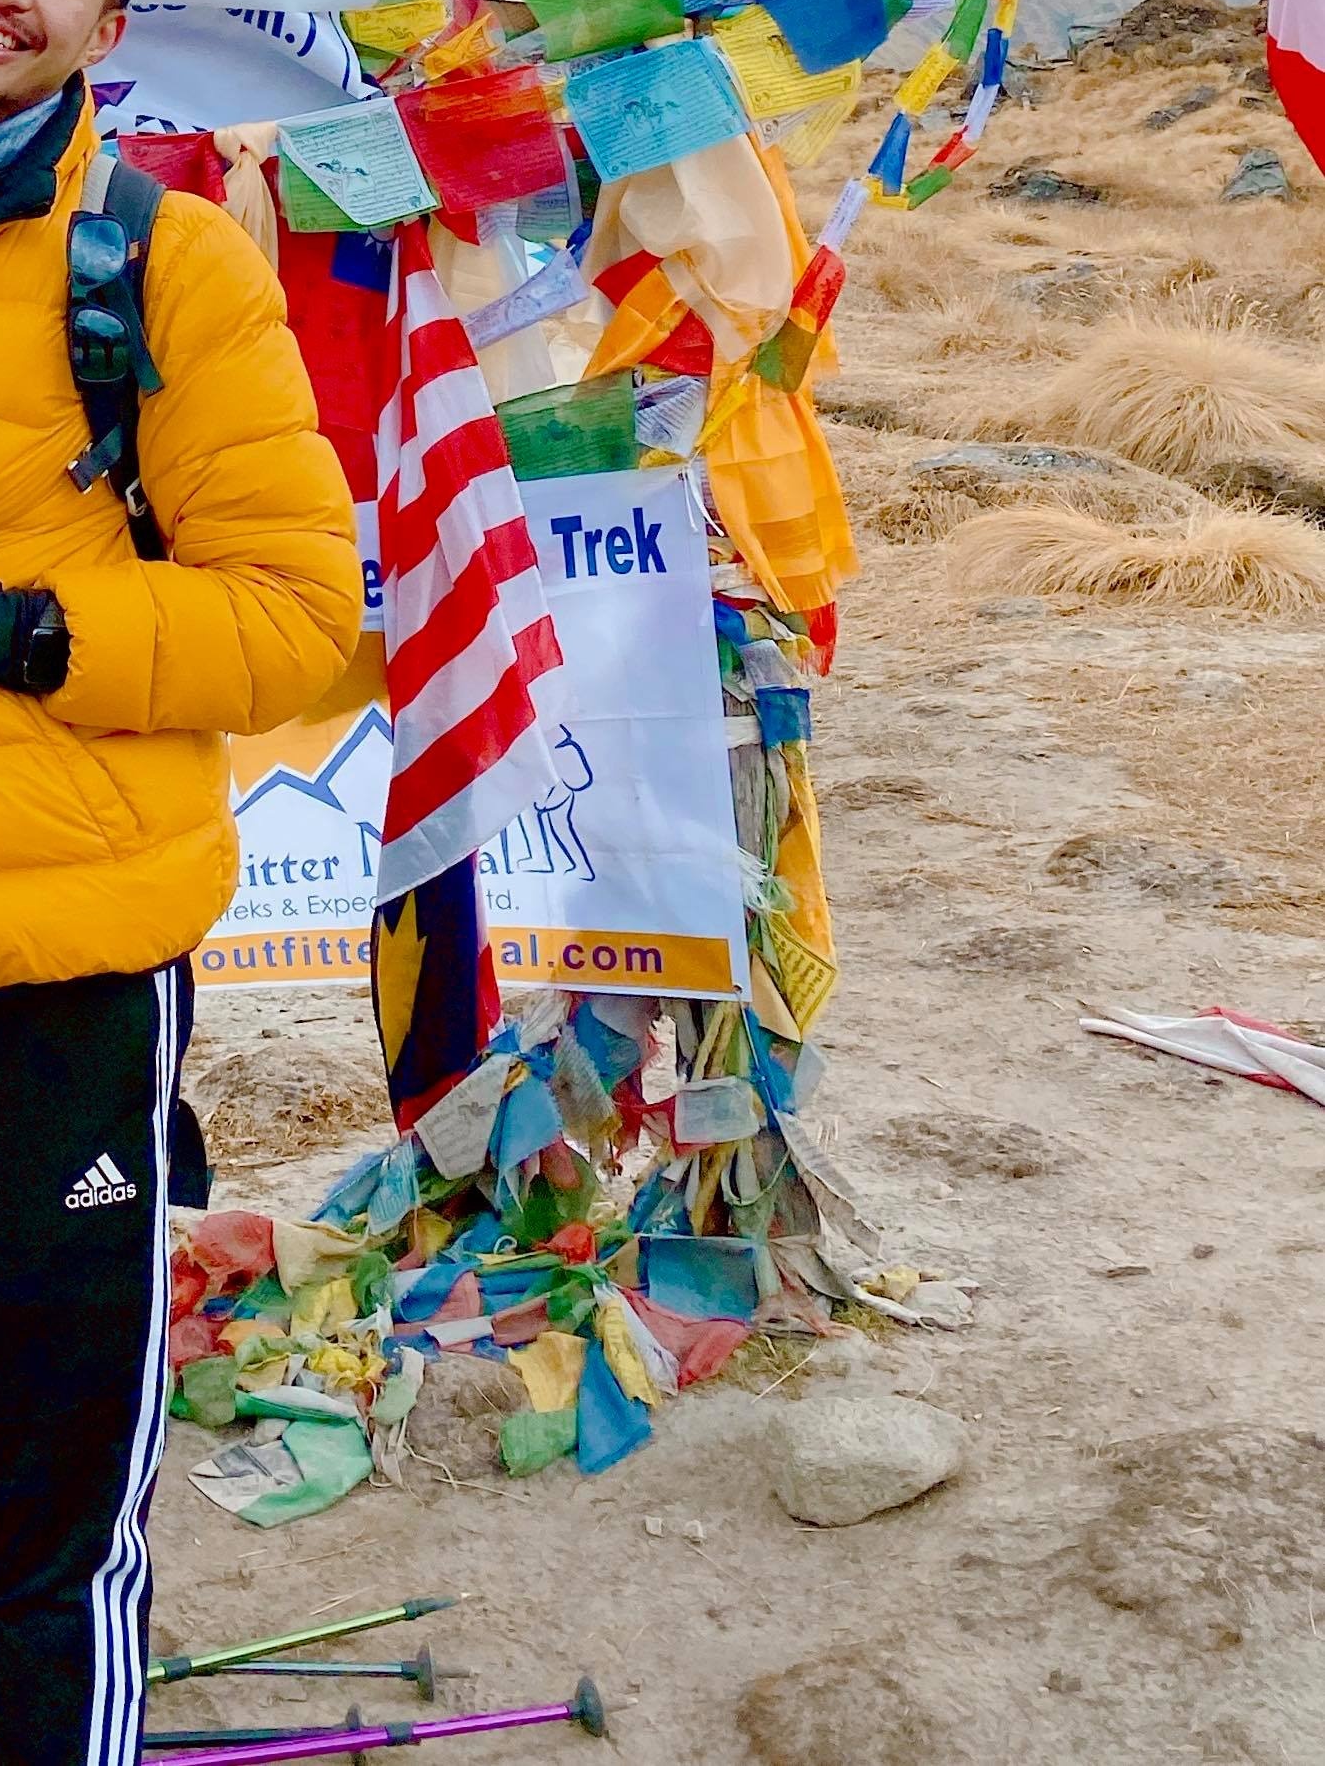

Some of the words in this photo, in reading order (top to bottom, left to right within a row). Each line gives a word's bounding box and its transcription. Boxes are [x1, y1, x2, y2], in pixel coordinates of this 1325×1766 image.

[551, 507, 667, 579] Trek
[239, 852, 340, 887] itter
[282, 898, 299, 916] &
[307, 894, 377, 919] Expe
[487, 889, 520, 911] td.
[64, 1183, 137, 1209] adidas
